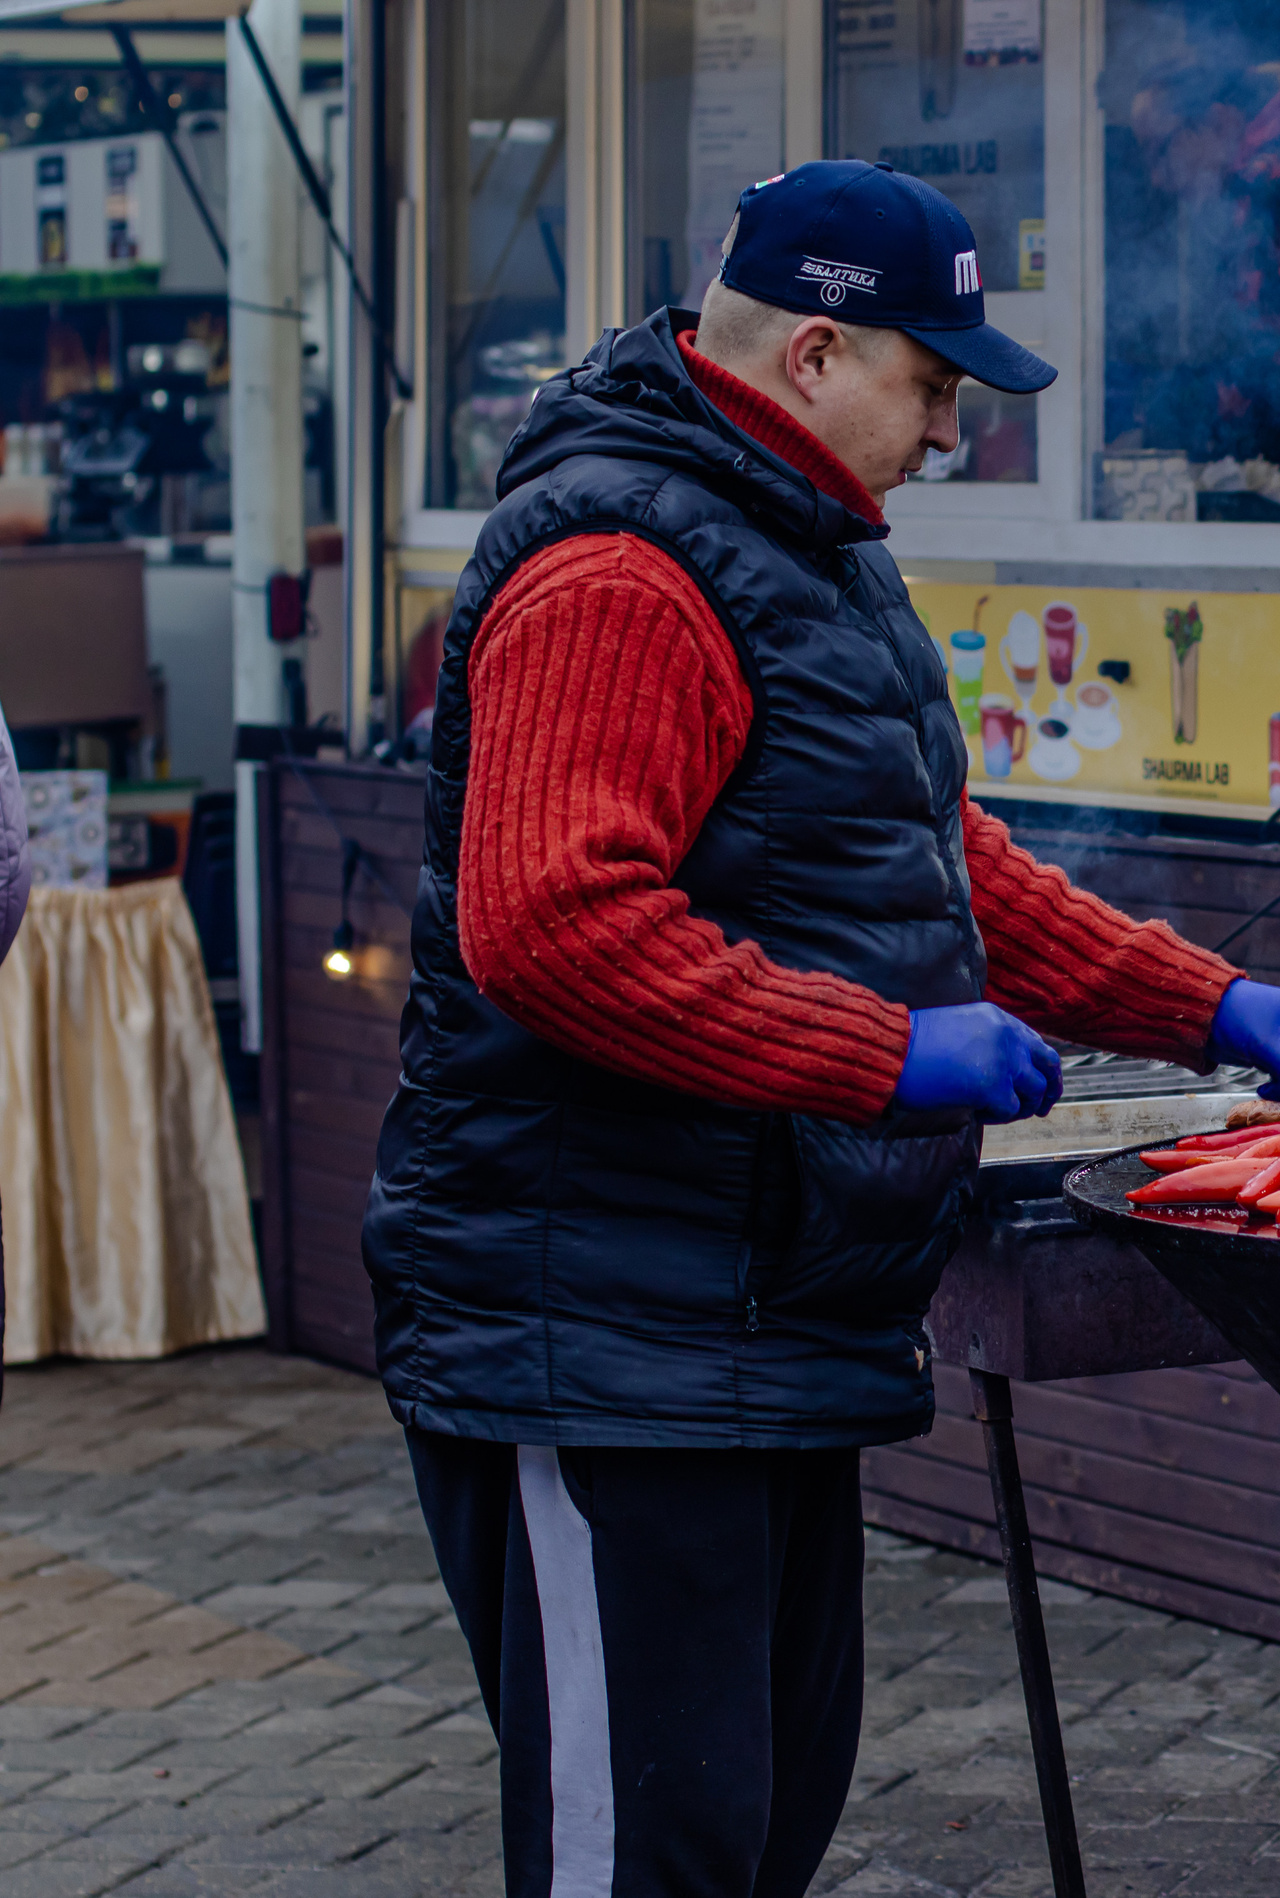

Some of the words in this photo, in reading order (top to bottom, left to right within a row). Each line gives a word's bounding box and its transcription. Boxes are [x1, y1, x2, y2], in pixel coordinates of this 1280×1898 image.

[813, 264, 876, 287] БАЛТИКА
[1143, 758, 1202, 782] SHAURMA
[1206, 762, 1229, 785] LAB
